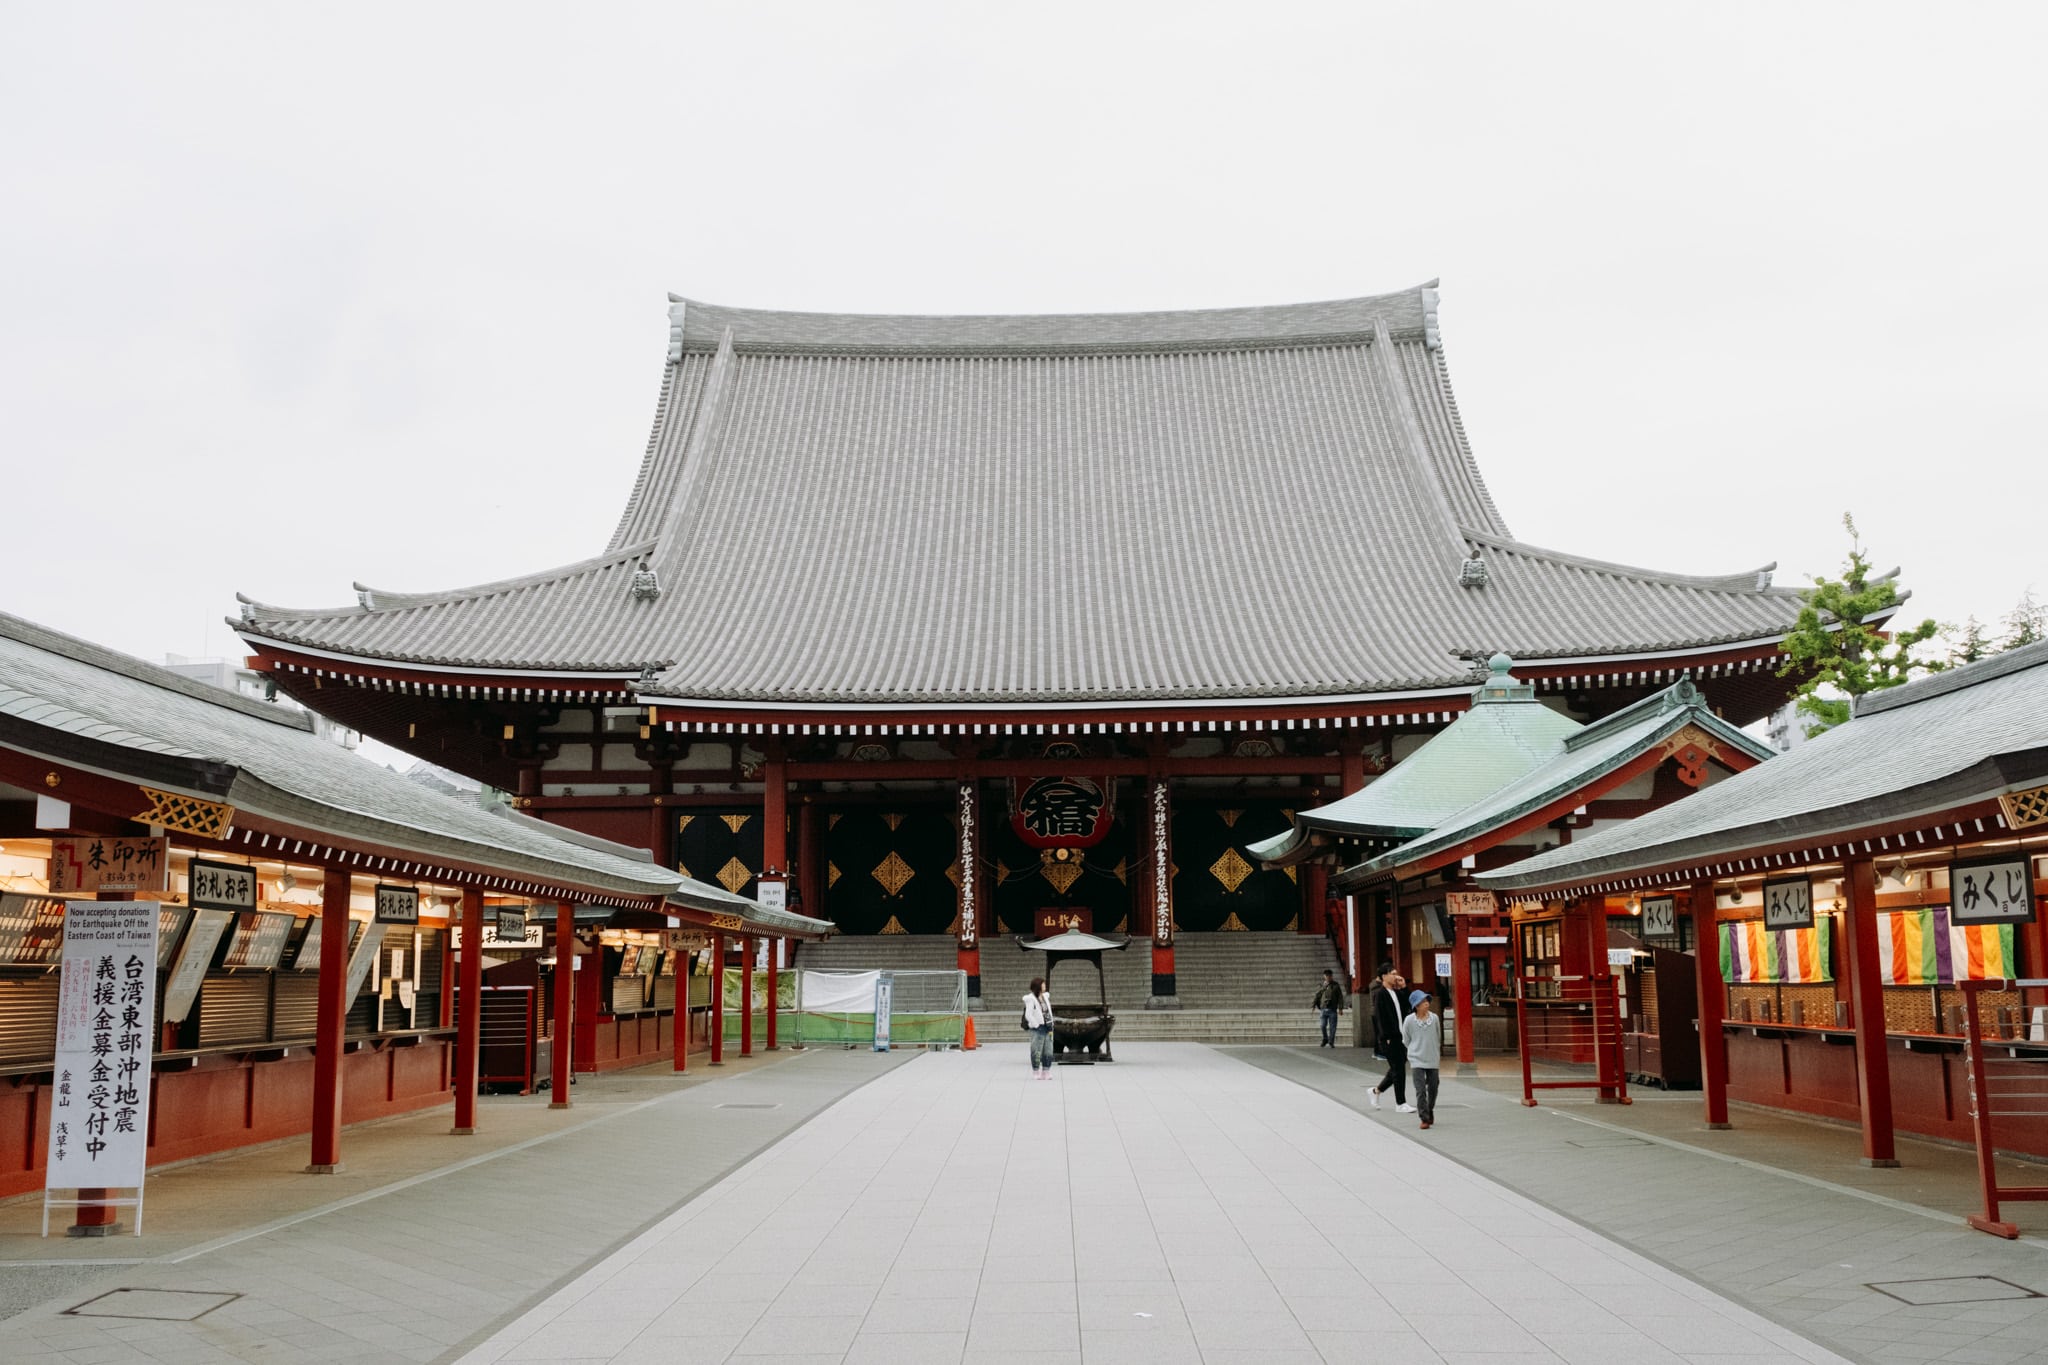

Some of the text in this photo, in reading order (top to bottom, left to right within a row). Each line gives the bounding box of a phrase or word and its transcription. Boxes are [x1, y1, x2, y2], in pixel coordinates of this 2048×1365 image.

[88, 840, 160, 872] 朱印所
[196, 870, 249, 903] お札お守
[1963, 869, 2023, 910] みくじ
[69, 907, 150, 919] Now accepting donations
[379, 895, 414, 917] お札お守
[1647, 904, 1673, 929] みくじ
[1770, 888, 1807, 918] みくじ
[68, 931, 152, 940] Eastern Coast of Taiwan
[69, 919, 149, 930] for Earthquake Off the
[85, 955, 116, 1162] 義援金募金受付中
[113, 954, 144, 1133] 台湾東部沖地震
[55, 1069, 72, 1161] 金龍山 浅草寺
